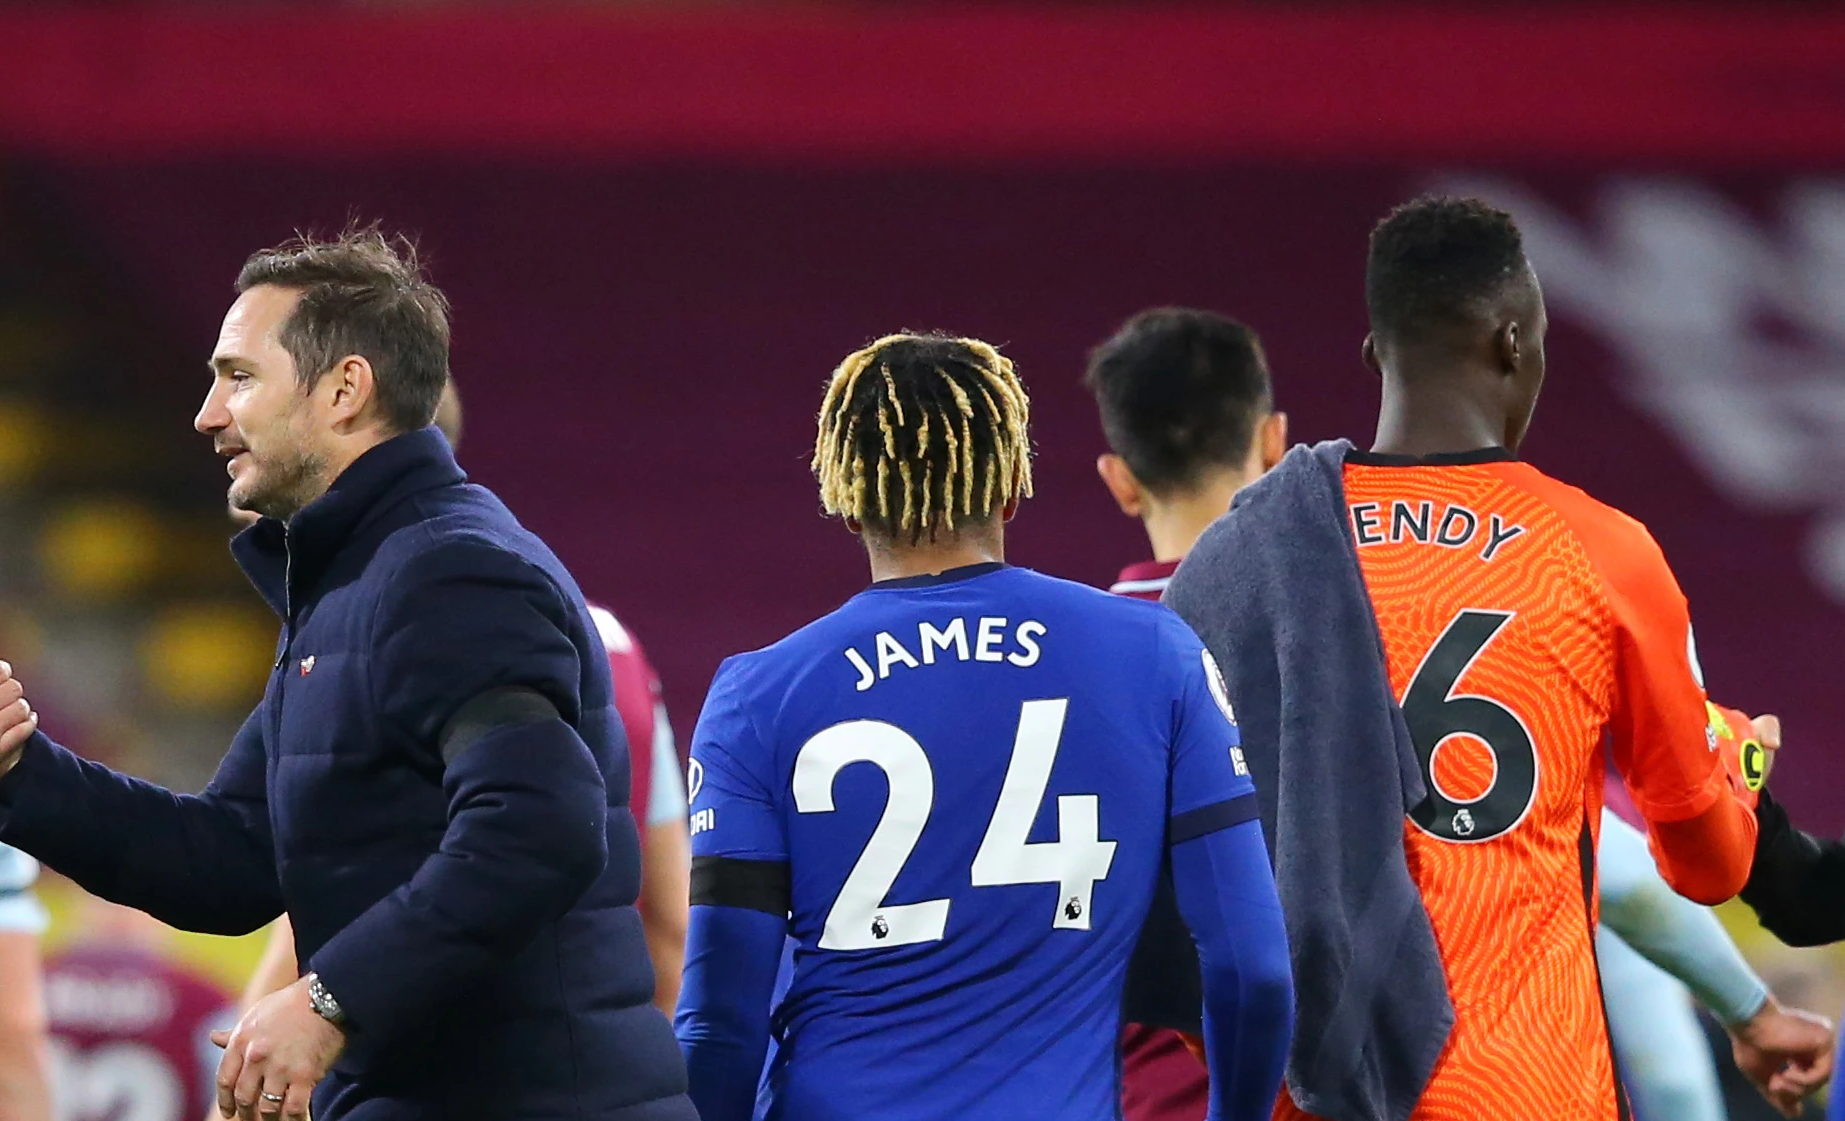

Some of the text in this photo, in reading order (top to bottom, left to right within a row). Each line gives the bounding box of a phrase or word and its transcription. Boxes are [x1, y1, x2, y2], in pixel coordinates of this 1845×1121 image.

[1349, 500, 1527, 563] ENDY
[843, 616, 1048, 692] JAMES
[1398, 607, 1540, 845] 6
[791, 697, 1118, 951] 24
